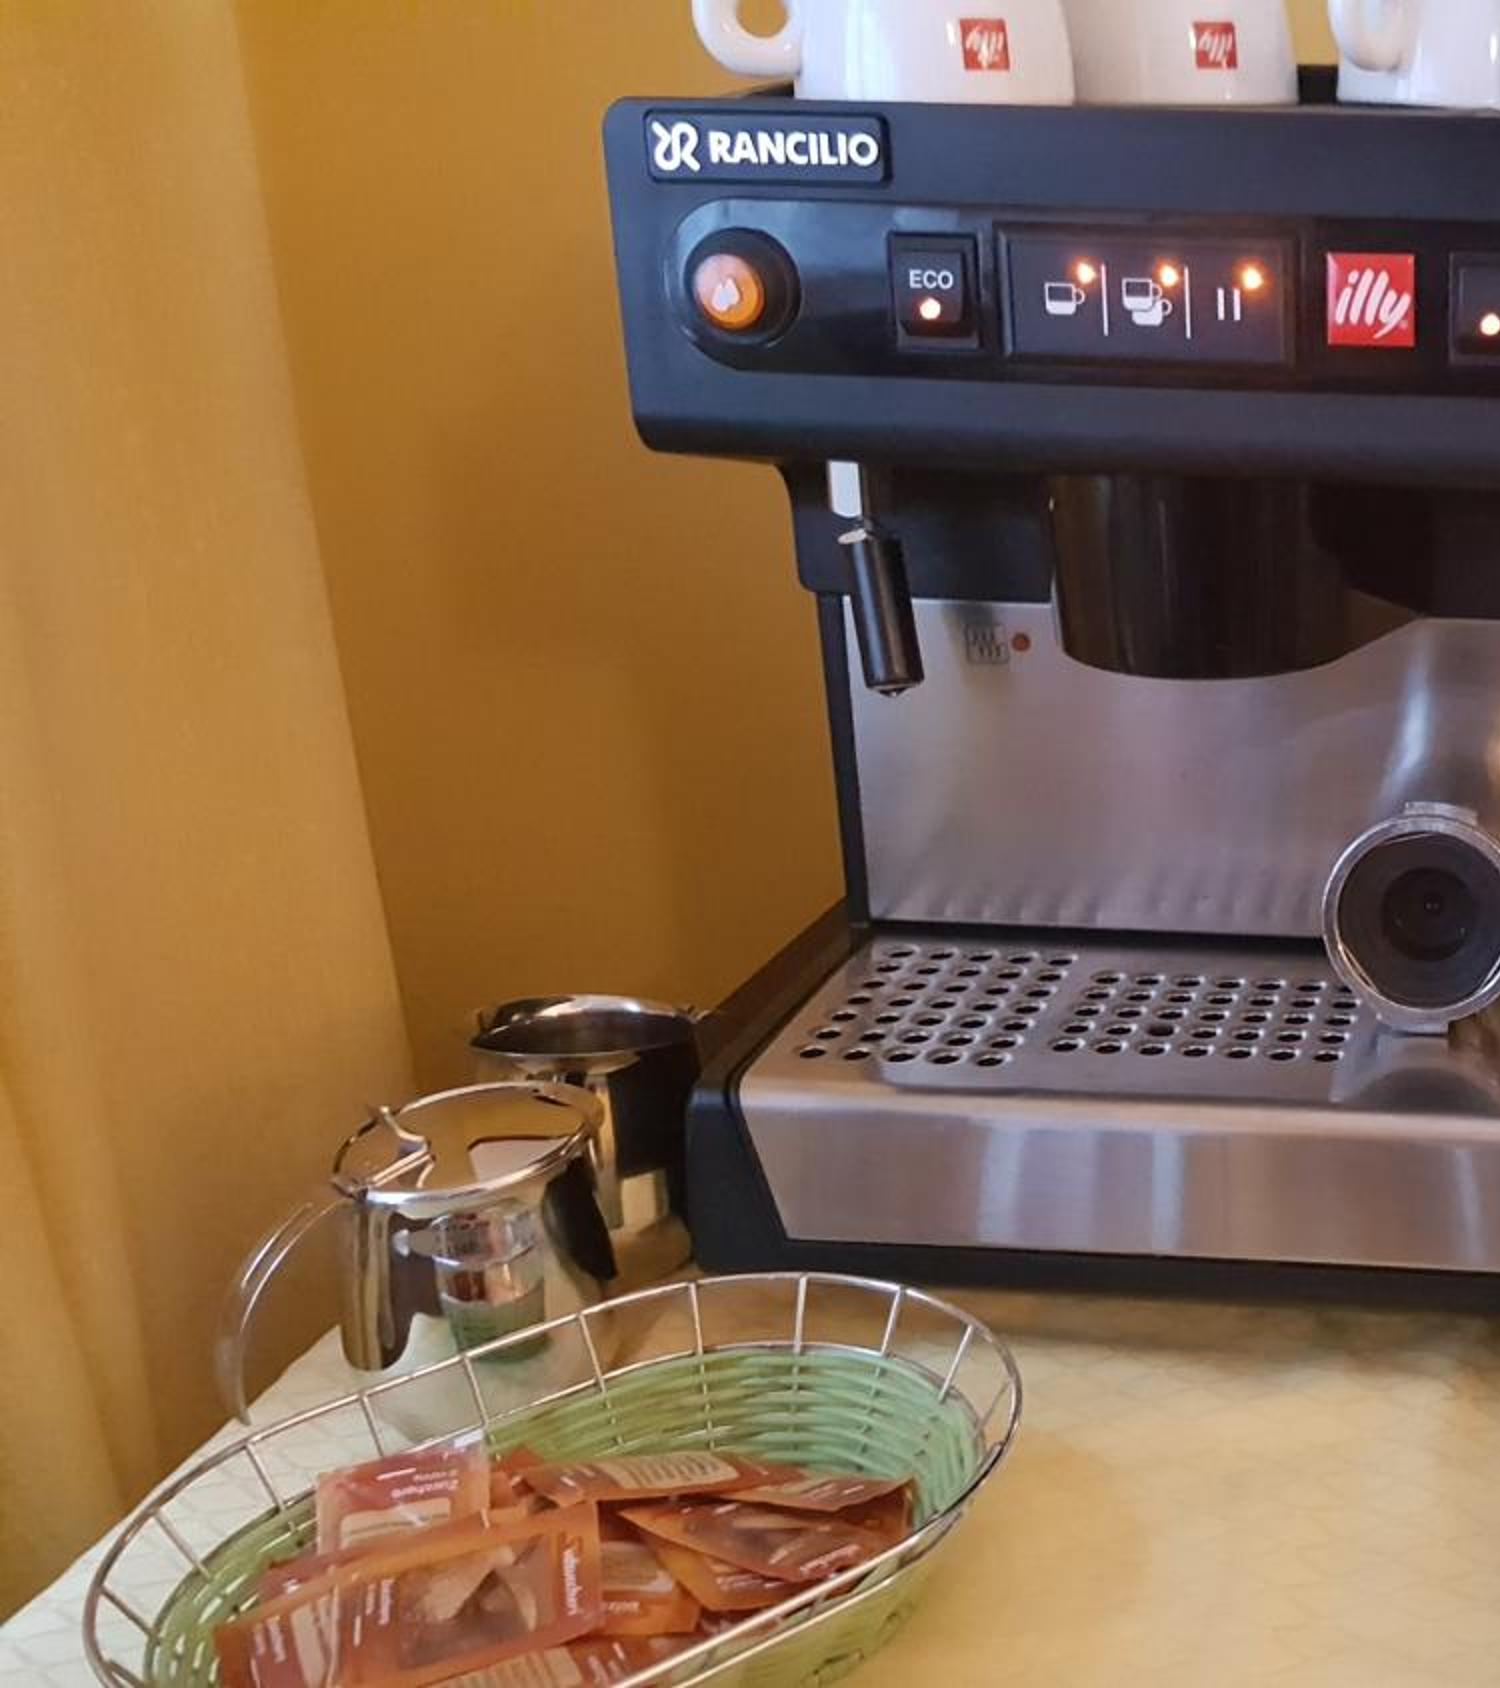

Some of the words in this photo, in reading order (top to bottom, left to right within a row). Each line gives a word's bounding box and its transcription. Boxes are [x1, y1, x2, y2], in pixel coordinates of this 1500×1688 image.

[707, 129, 879, 167] RANCILIO
[908, 269, 954, 290] ECO
[1335, 267, 1411, 339] illy
